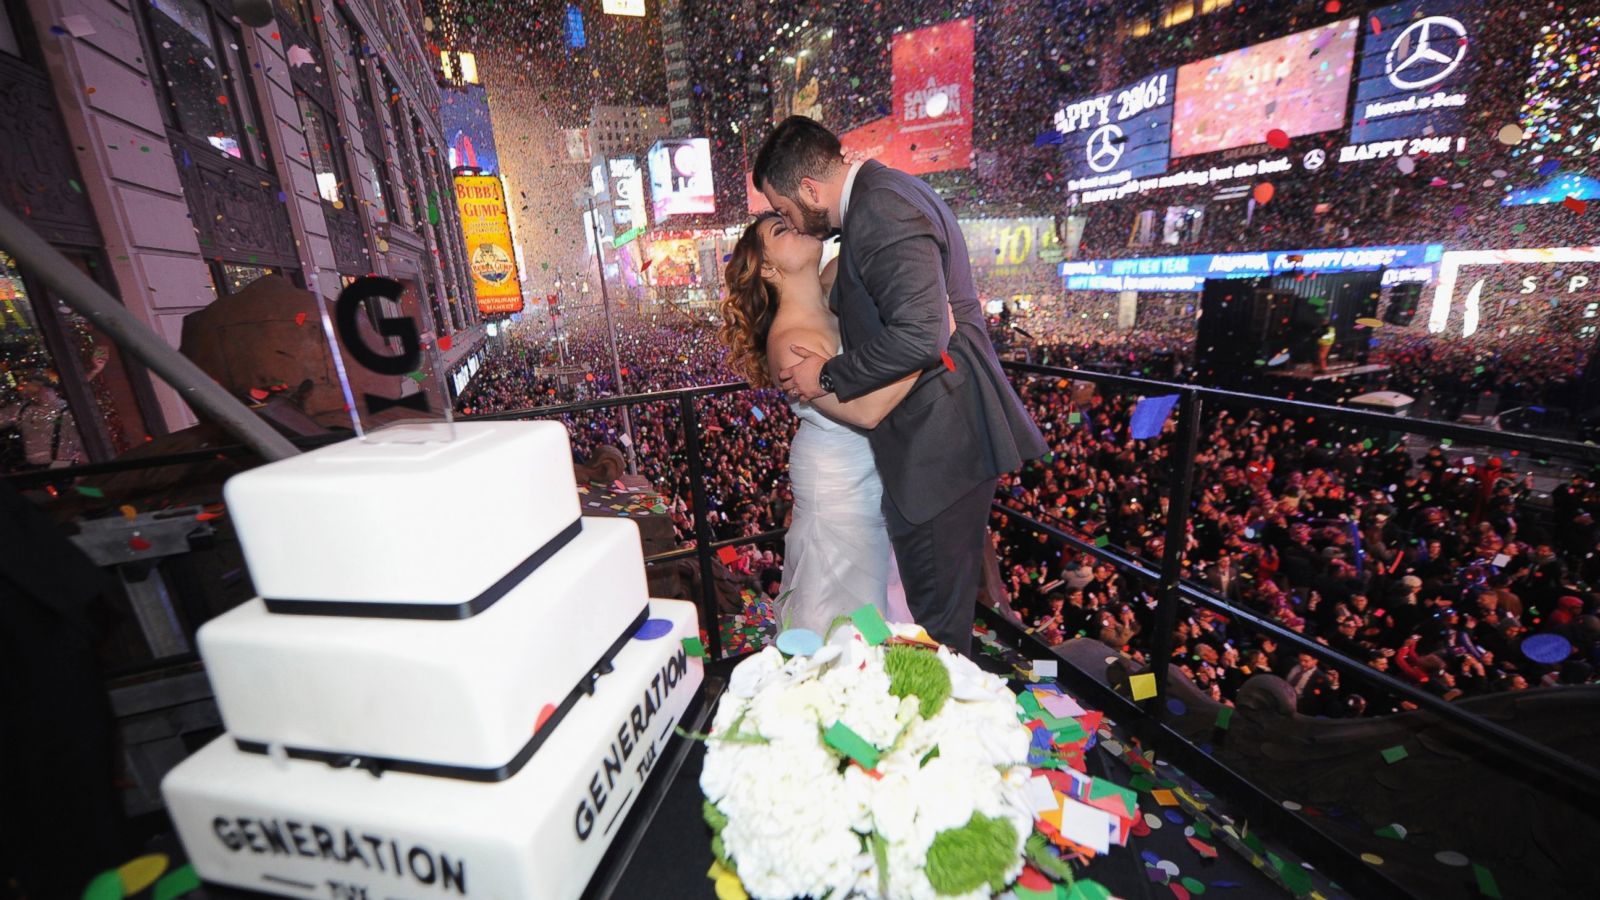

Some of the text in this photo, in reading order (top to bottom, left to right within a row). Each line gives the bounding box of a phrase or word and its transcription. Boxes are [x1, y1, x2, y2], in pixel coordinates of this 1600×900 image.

[918, 98, 961, 119] BN
[1339, 140, 1408, 162] HAPPY
[456, 183, 499, 199] BUBBA
[463, 203, 500, 217] GUMP
[335, 275, 421, 376] G
[575, 648, 688, 842] GENERATION
[636, 740, 657, 782] TUX
[212, 816, 466, 895] GENERATION
